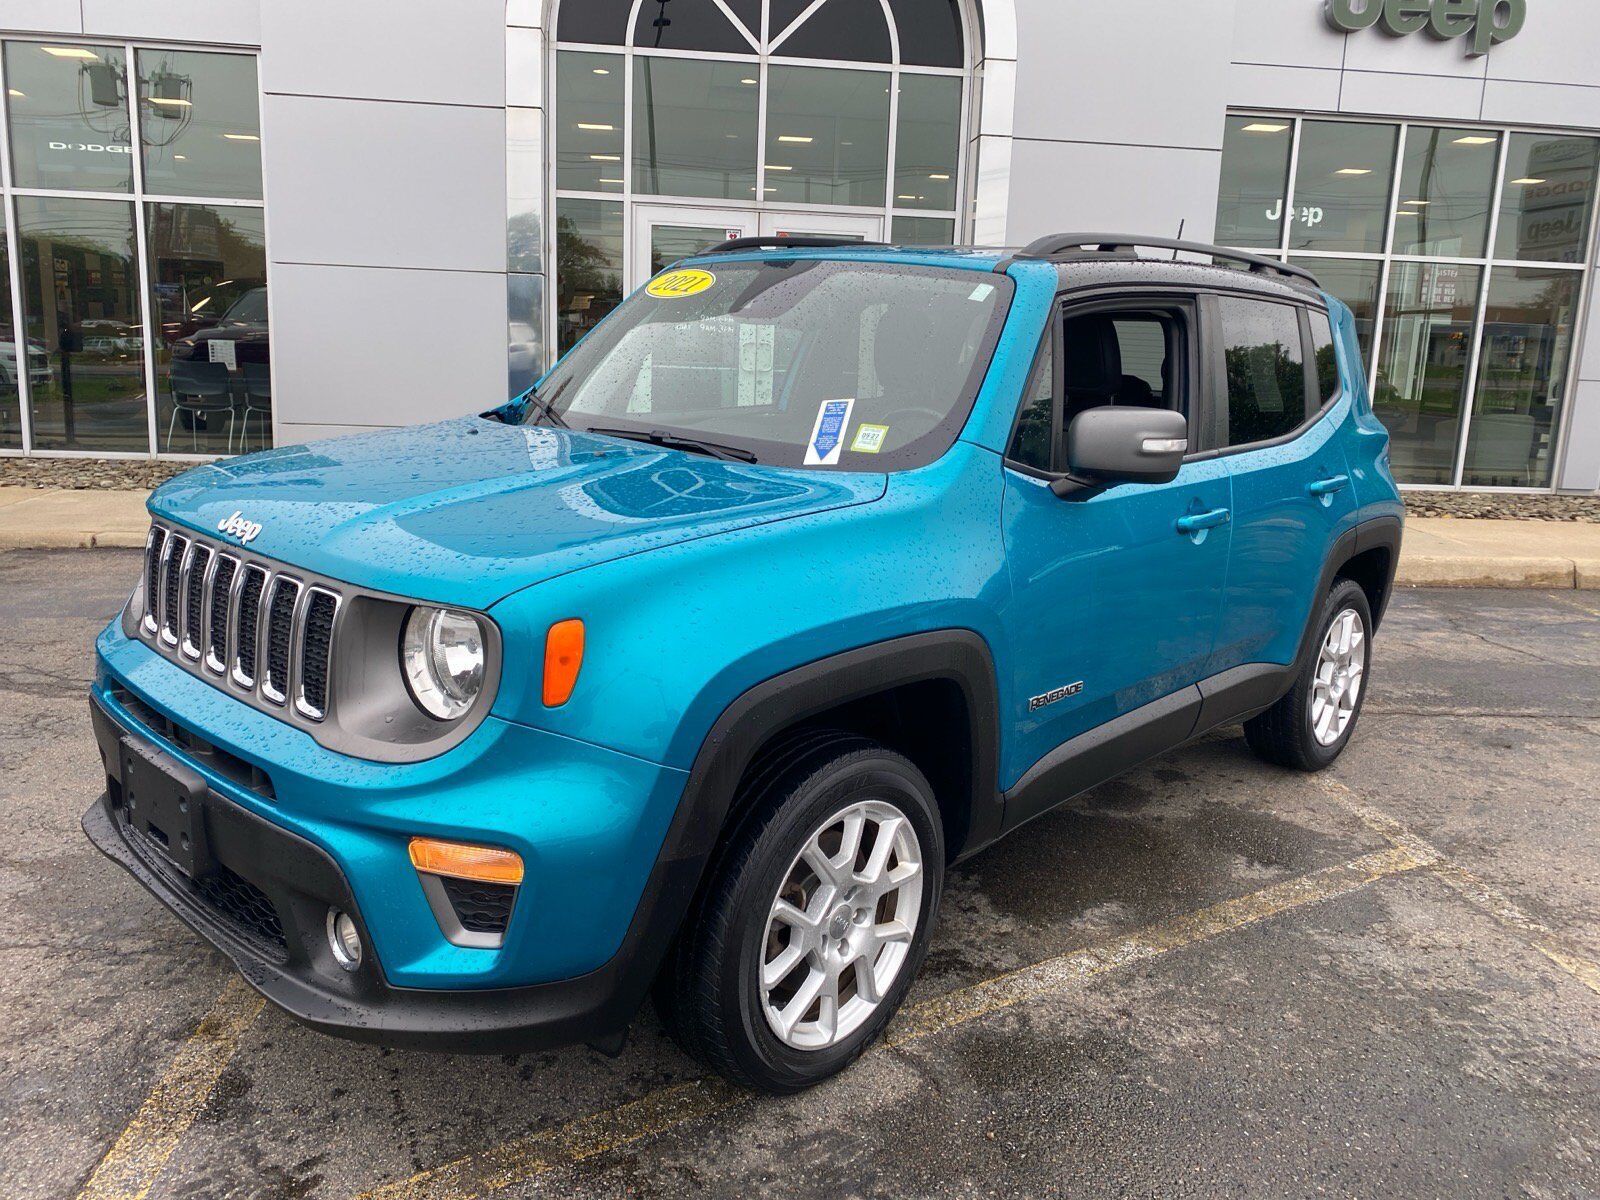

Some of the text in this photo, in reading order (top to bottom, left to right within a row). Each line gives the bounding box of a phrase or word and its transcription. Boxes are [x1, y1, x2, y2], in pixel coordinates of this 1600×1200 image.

[651, 275, 709, 292] 2021
[217, 510, 263, 546] Jeep
[1028, 680, 1084, 712] RENEGADE
